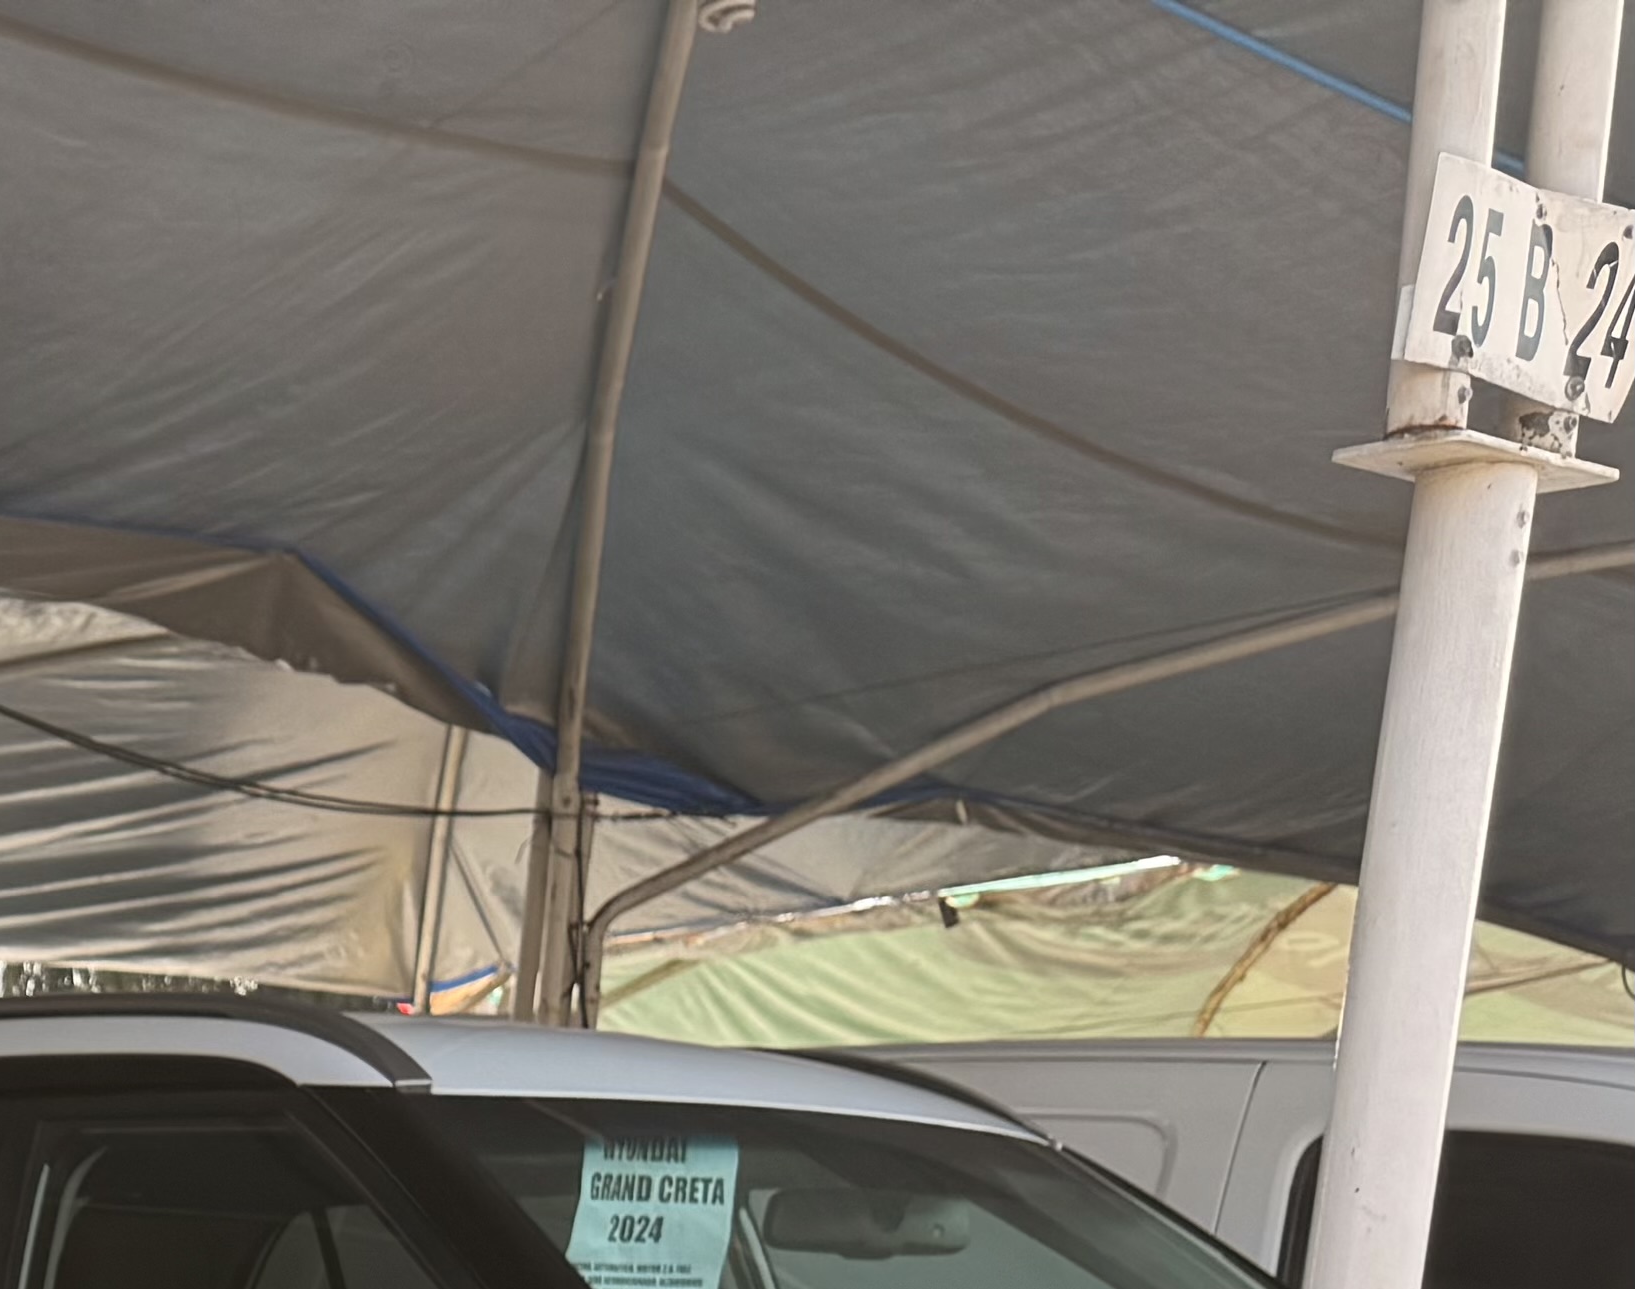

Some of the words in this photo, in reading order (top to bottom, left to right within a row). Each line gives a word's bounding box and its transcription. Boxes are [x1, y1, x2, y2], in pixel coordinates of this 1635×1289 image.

[1432, 194, 1505, 348] 25
[1515, 219, 1554, 362] B
[1563, 241, 1635, 388] 24
[590, 1172, 653, 1202] GRAND
[658, 1174, 725, 1206] CRETA
[607, 1213, 664, 1243] 2024
